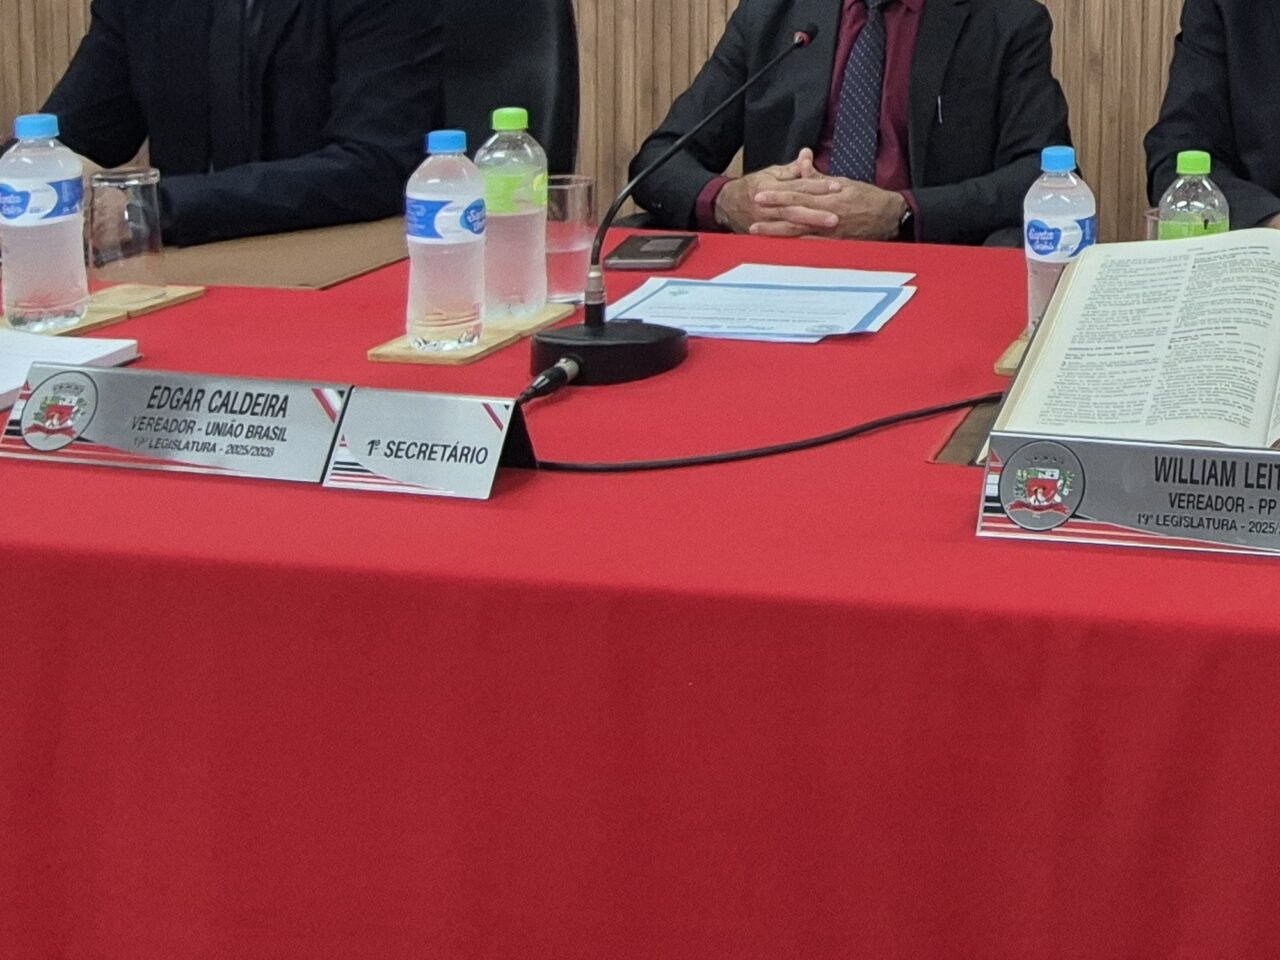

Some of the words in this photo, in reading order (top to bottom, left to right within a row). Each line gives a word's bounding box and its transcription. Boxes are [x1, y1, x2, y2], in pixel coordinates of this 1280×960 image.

[146, 385, 206, 412] EDGAR
[207, 389, 289, 418] CALDEIRA
[131, 416, 197, 435] VEREADOR
[204, 419, 244, 438] UNIÃO
[244, 424, 288, 442] BRASIL
[148, 437, 217, 454] LEGISLATURA
[383, 440, 489, 465] SECRETÁRIO
[1154, 455, 1237, 487] WILLIAM
[1168, 492, 1245, 513] VEREADOR
[1258, 498, 1277, 515] PP
[1155, 514, 1238, 532] LEGISLATURA
